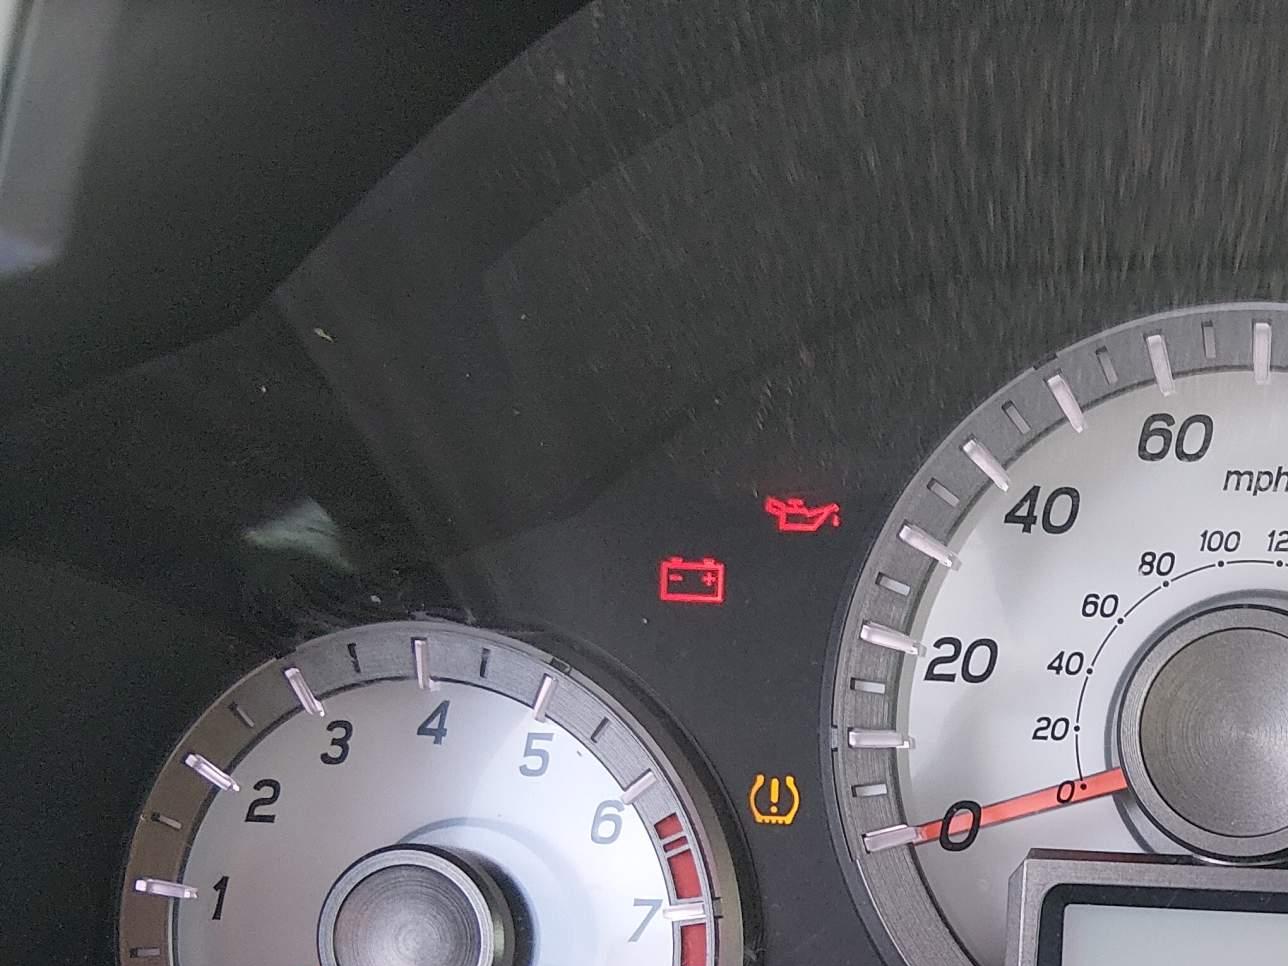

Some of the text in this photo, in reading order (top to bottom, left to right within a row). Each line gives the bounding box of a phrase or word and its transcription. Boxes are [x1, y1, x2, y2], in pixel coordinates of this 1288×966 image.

[1138, 413, 1213, 462] 60
[1004, 485, 1080, 534] 40
[1200, 530, 1240, 552] 100
[1139, 552, 1175, 576] 80
[1081, 594, 1119, 617] 60
[924, 637, 998, 683] 20
[1047, 651, 1084, 675] 40
[321, 720, 352, 764] 3
[417, 700, 449, 744] 4
[1032, 717, 1069, 740] 20
[519, 732, 554, 776] 5
[245, 779, 280, 823] 2
[1056, 780, 1076, 804] 0
[591, 801, 623, 845] 6
[938, 800, 981, 851] 0
[212, 876, 229, 920] 1
[628, 898, 662, 942] 7
